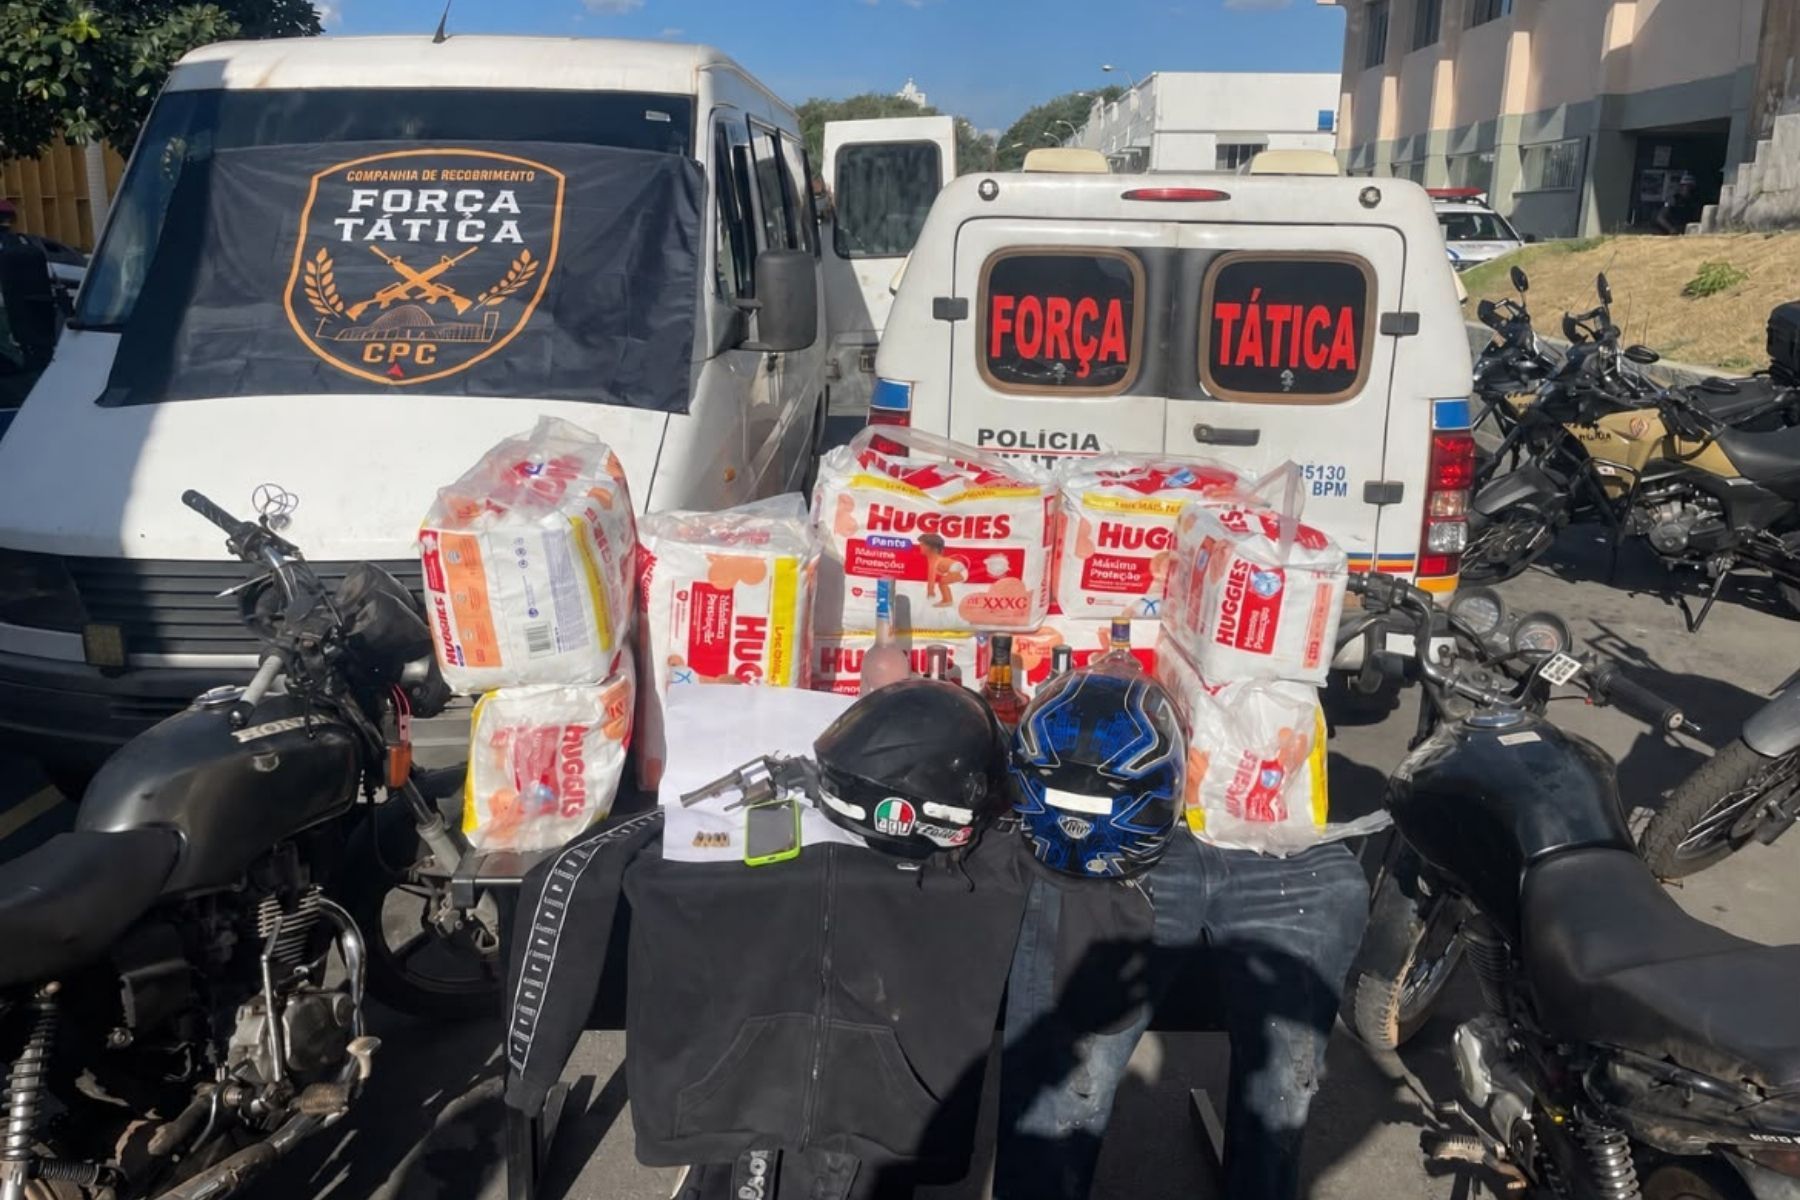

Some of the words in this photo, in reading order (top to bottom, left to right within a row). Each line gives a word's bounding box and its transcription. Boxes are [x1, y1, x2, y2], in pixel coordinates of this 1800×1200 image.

[347, 169, 418, 182] COMPANHIA
[422, 170, 438, 182] DE
[441, 170, 535, 182] RECOBRIMENTO
[347, 189, 521, 219] FORÇA
[334, 213, 524, 244] TÁTICA
[991, 295, 1128, 378] FORÇA
[1215, 287, 1357, 371] TÁTICA
[363, 342, 438, 365] CPC
[977, 428, 1101, 451] POLÍCIA
[1312, 481, 1348, 497] BPM
[866, 503, 1011, 540] HUGGIES
[1215, 558, 1249, 648] HUGGIES
